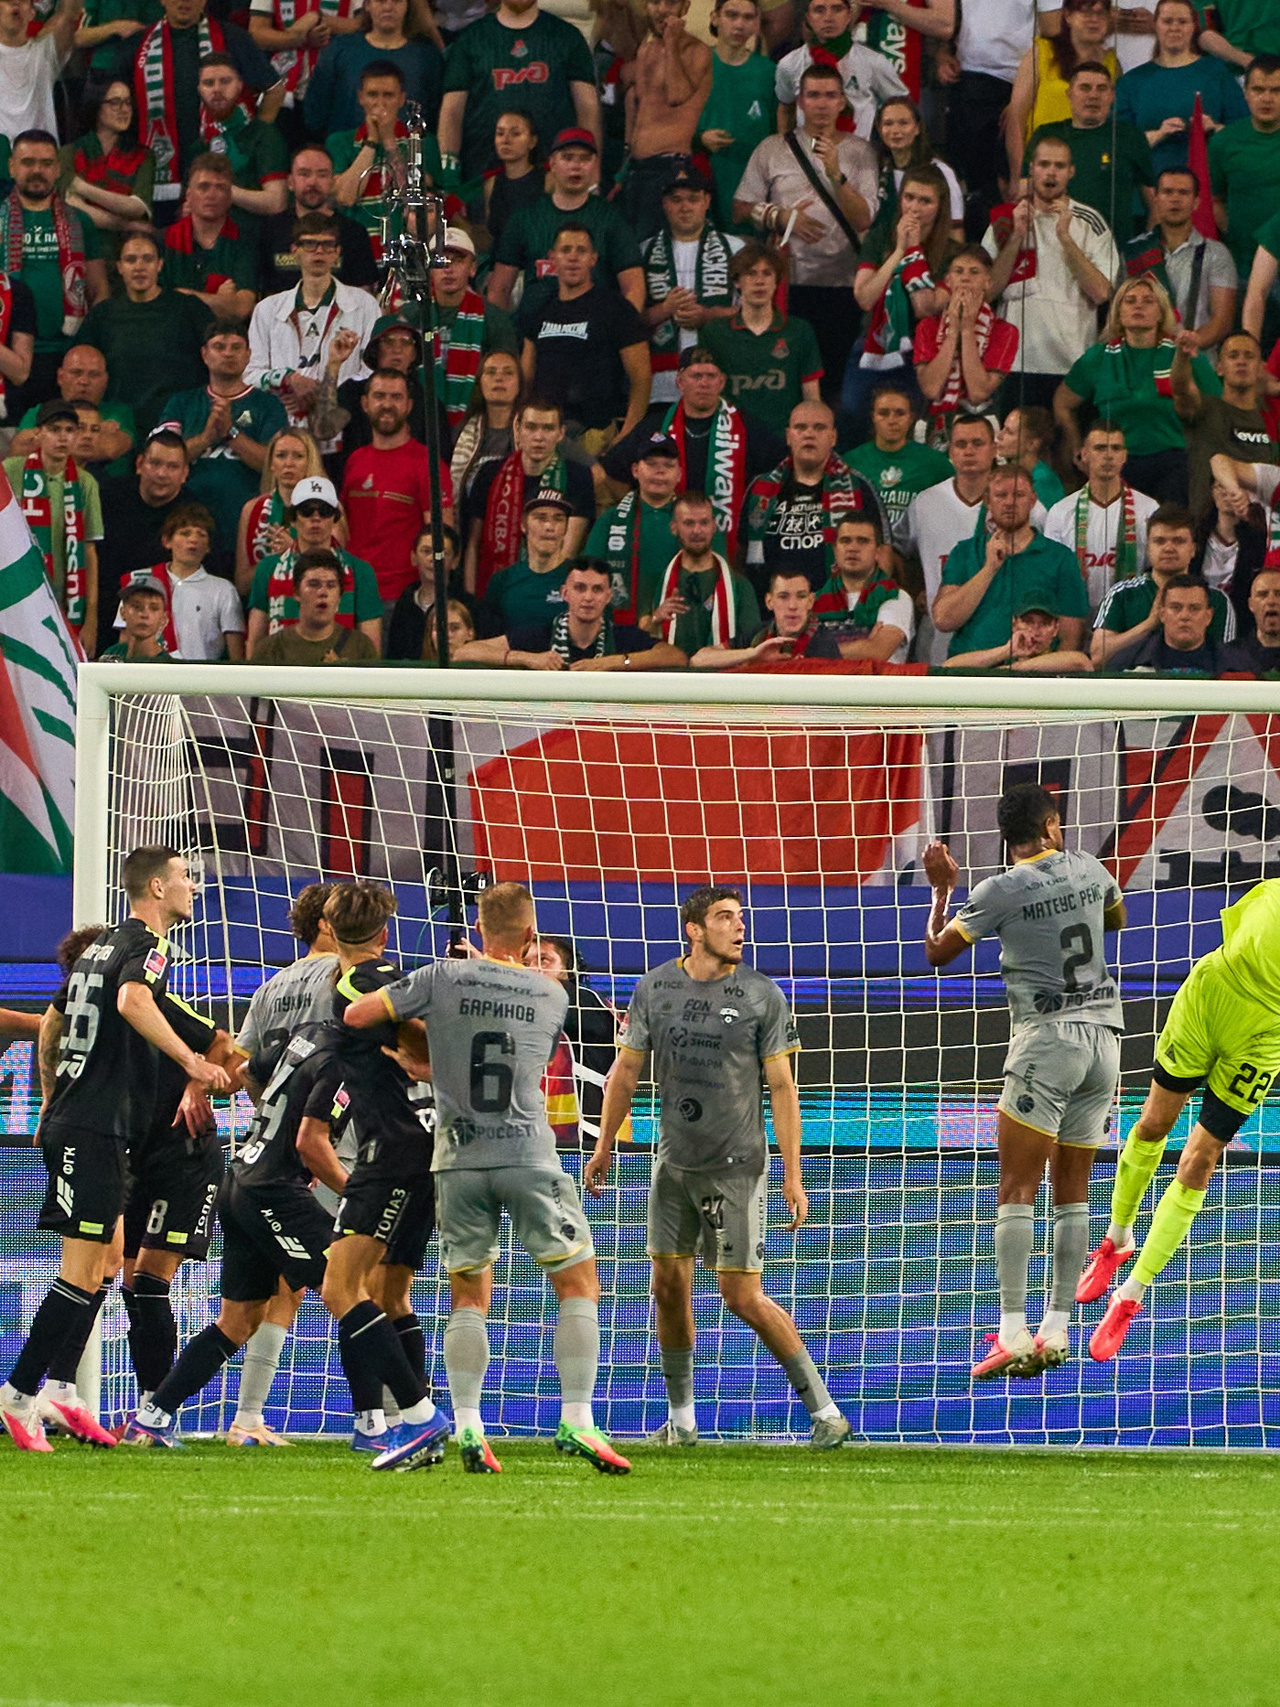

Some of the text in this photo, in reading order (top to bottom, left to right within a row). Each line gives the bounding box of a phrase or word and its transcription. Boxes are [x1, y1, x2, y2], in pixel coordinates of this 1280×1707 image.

[1022, 895, 1078, 921] МАТЕУС
[1060, 922, 1094, 994] 2
[458, 997, 536, 1023] БАРИНОВ
[469, 1030, 516, 1113] 6
[1227, 1062, 1272, 1105] 22
[146, 1199, 169, 1235] 8
[193, 1183, 217, 1236] ТОПАЗ
[373, 1187, 406, 1240] ТОПАЗ
